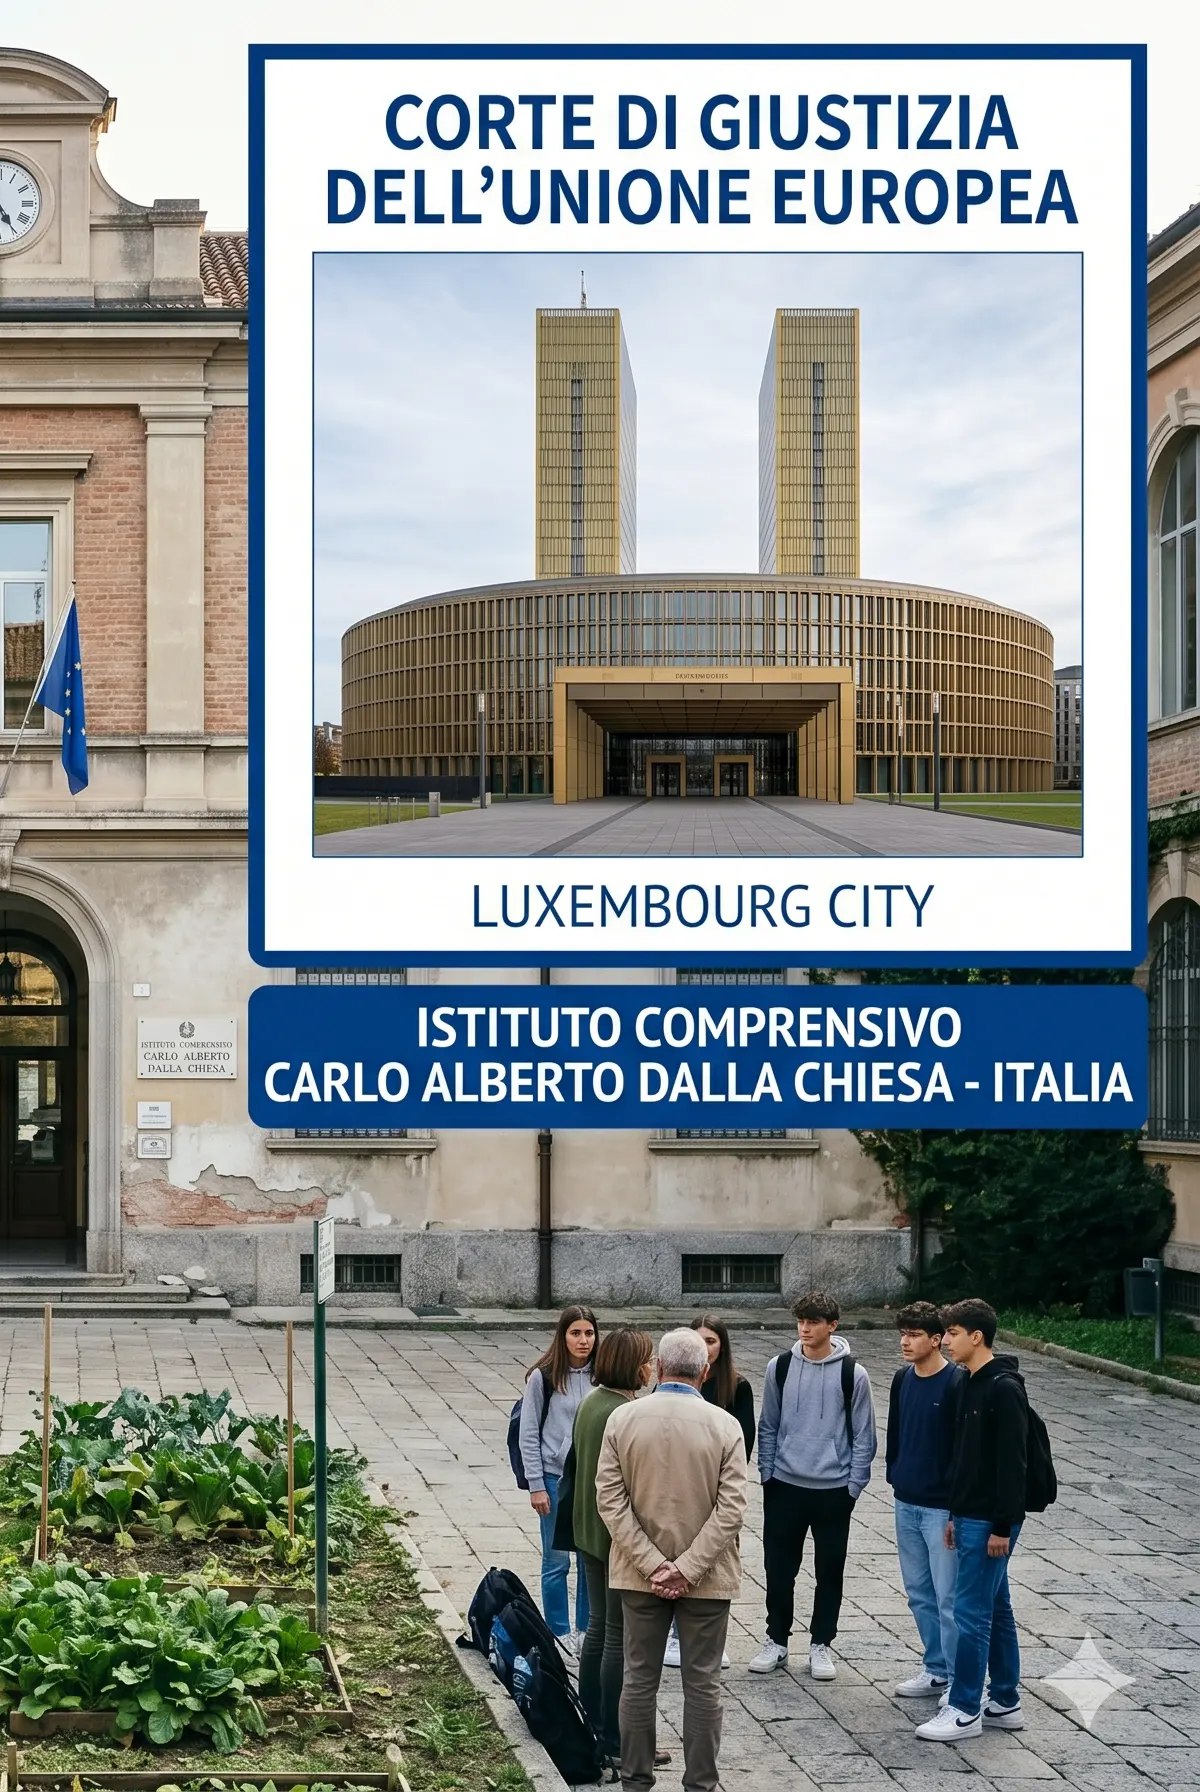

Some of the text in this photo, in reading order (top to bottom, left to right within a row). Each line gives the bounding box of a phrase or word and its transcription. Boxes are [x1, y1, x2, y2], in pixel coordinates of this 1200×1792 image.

[143, 1052, 230, 1061] CARLO ALBERTO
[147, 1064, 183, 1073] DALLA
